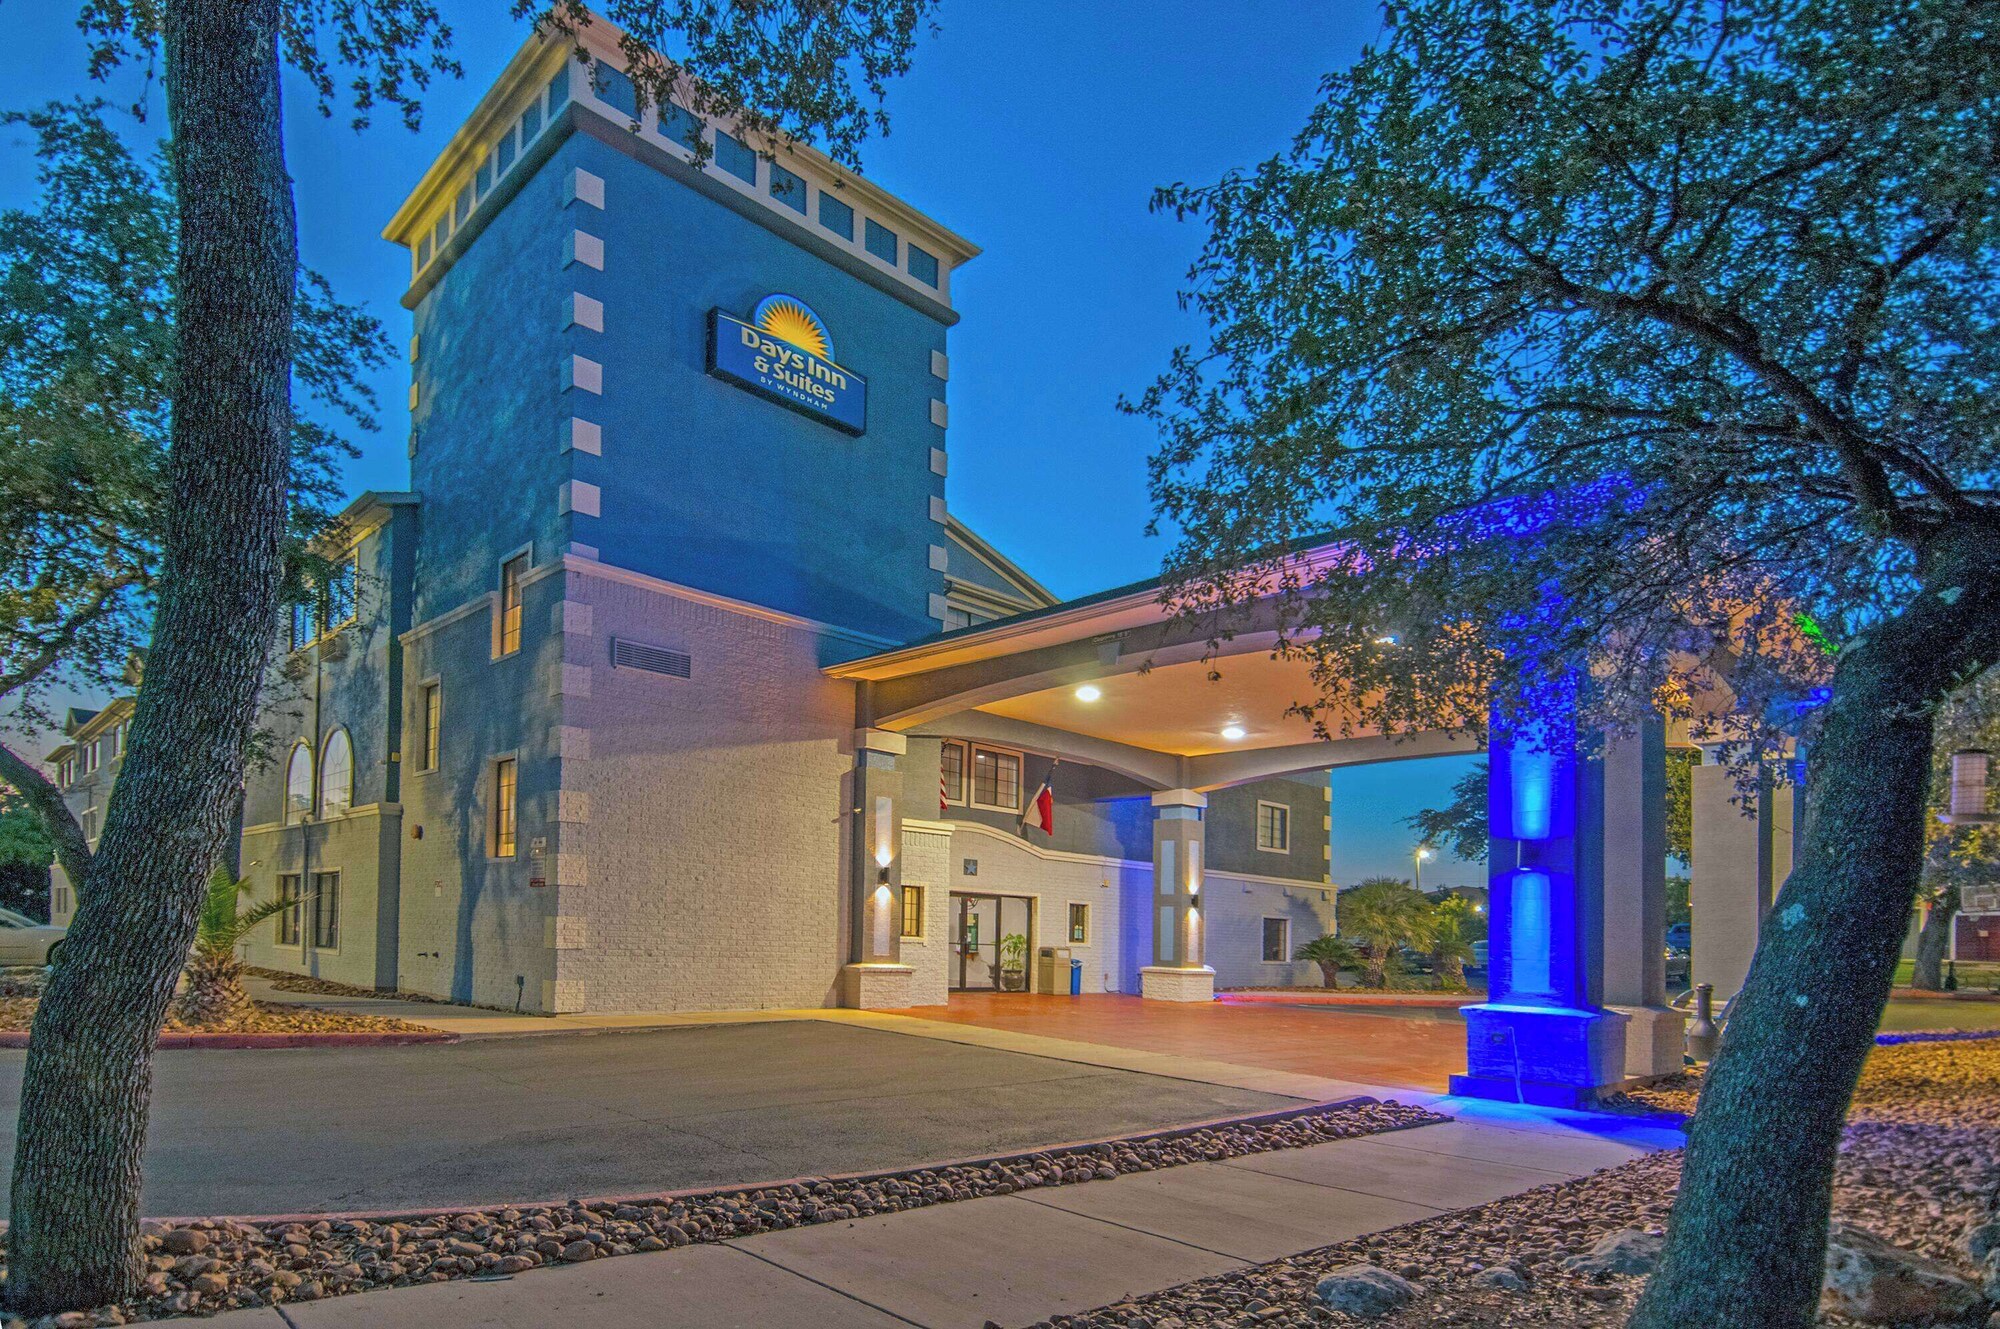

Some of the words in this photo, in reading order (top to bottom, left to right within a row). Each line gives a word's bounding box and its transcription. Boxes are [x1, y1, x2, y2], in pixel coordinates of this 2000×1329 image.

[741, 326, 805, 369] Days
[808, 356, 846, 390] Inn
[753, 355, 770, 373] &
[772, 363, 835, 403] Suites
[760, 376, 773, 386] BY
[777, 383, 828, 410] WYNDHAM
